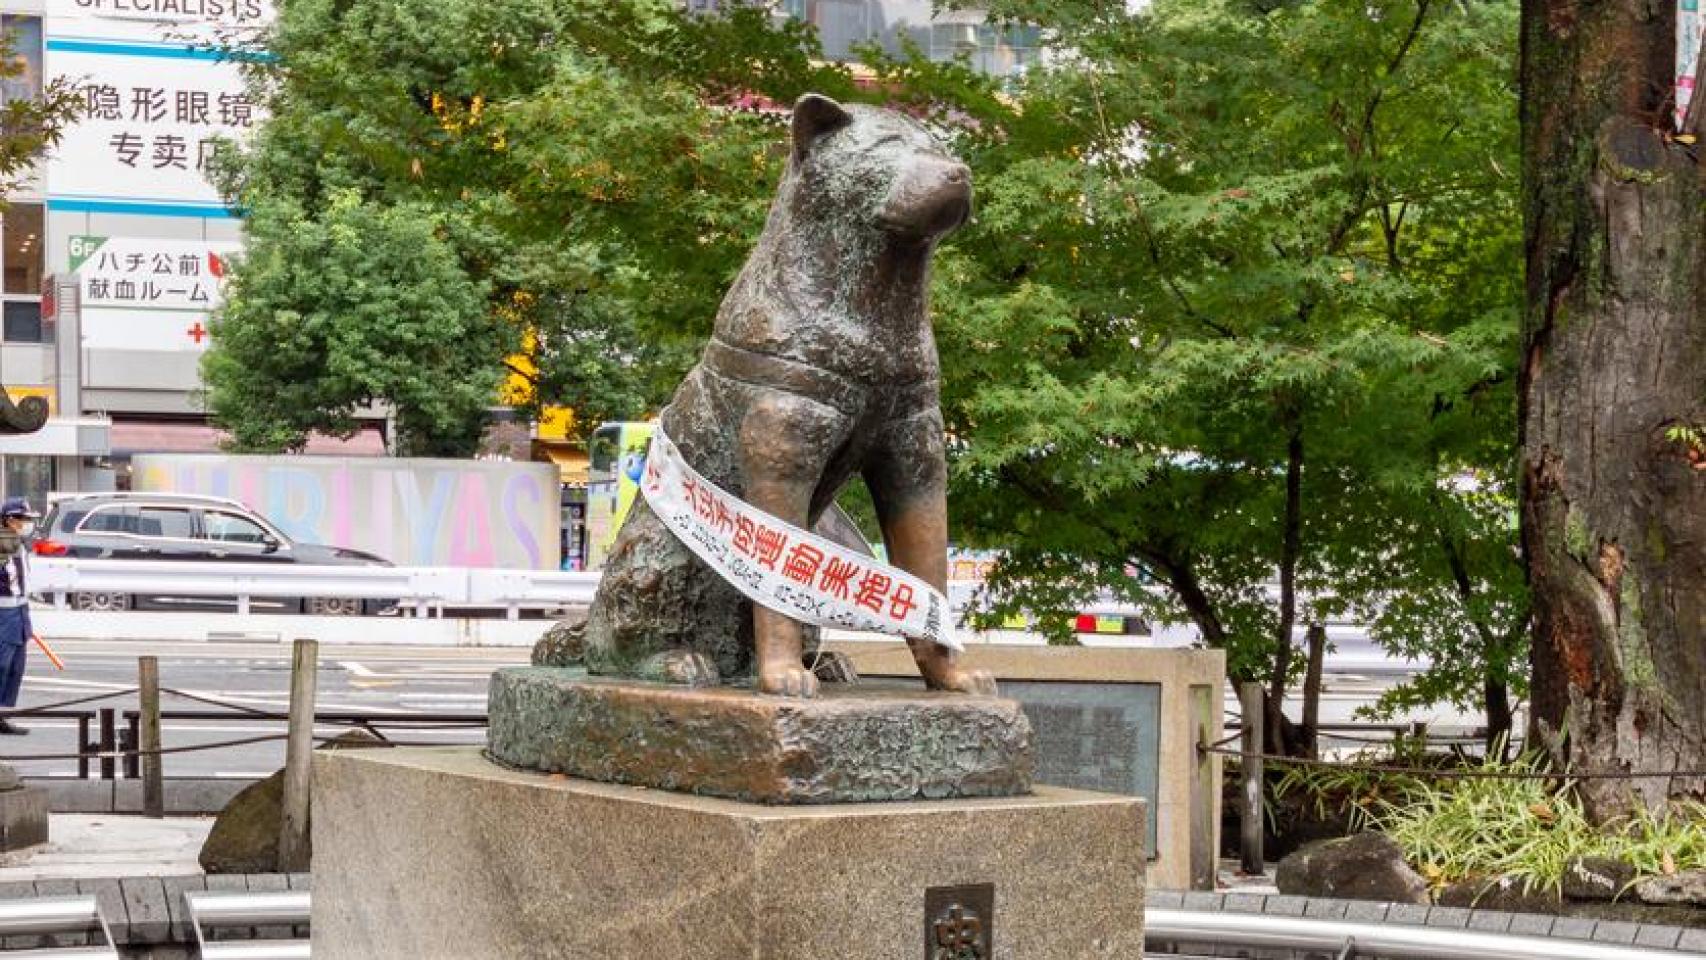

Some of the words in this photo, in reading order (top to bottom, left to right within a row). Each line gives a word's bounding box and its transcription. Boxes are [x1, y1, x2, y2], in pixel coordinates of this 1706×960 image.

[86, 84, 253, 127] 隐形眼镜
[98, 252, 200, 277] ハチ公前
[88, 278, 209, 302] 献血ルーム
